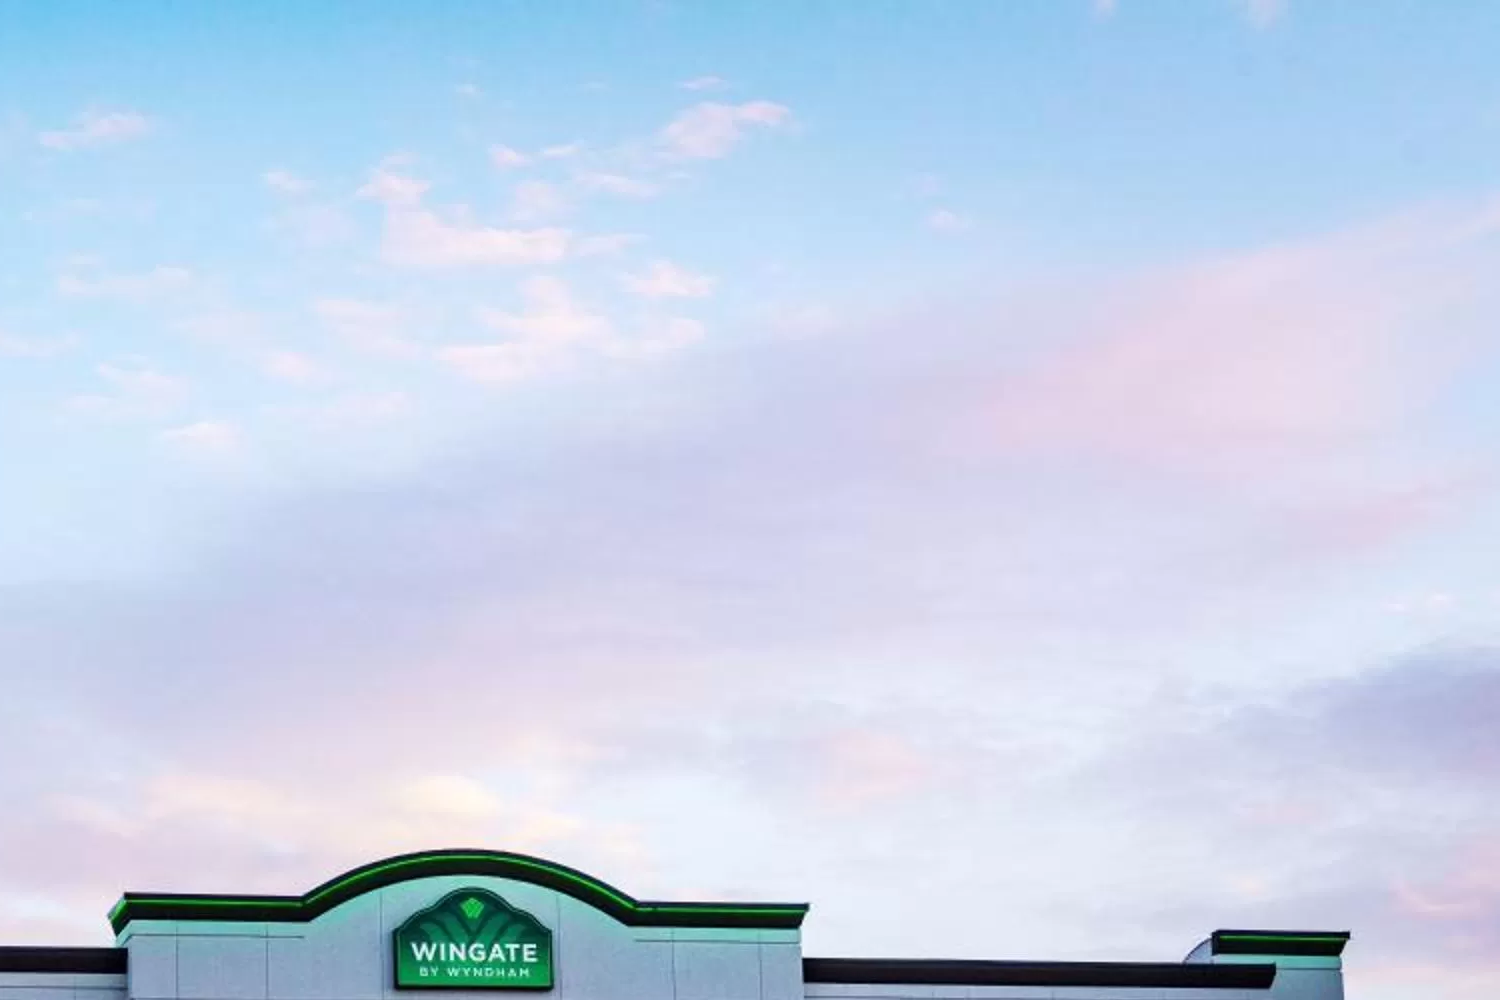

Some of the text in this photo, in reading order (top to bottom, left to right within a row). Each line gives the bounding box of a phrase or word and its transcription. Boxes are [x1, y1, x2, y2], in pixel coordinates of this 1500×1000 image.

[411, 942, 538, 963] WINGATE
[419, 967, 531, 978] BY WYNDHAM
